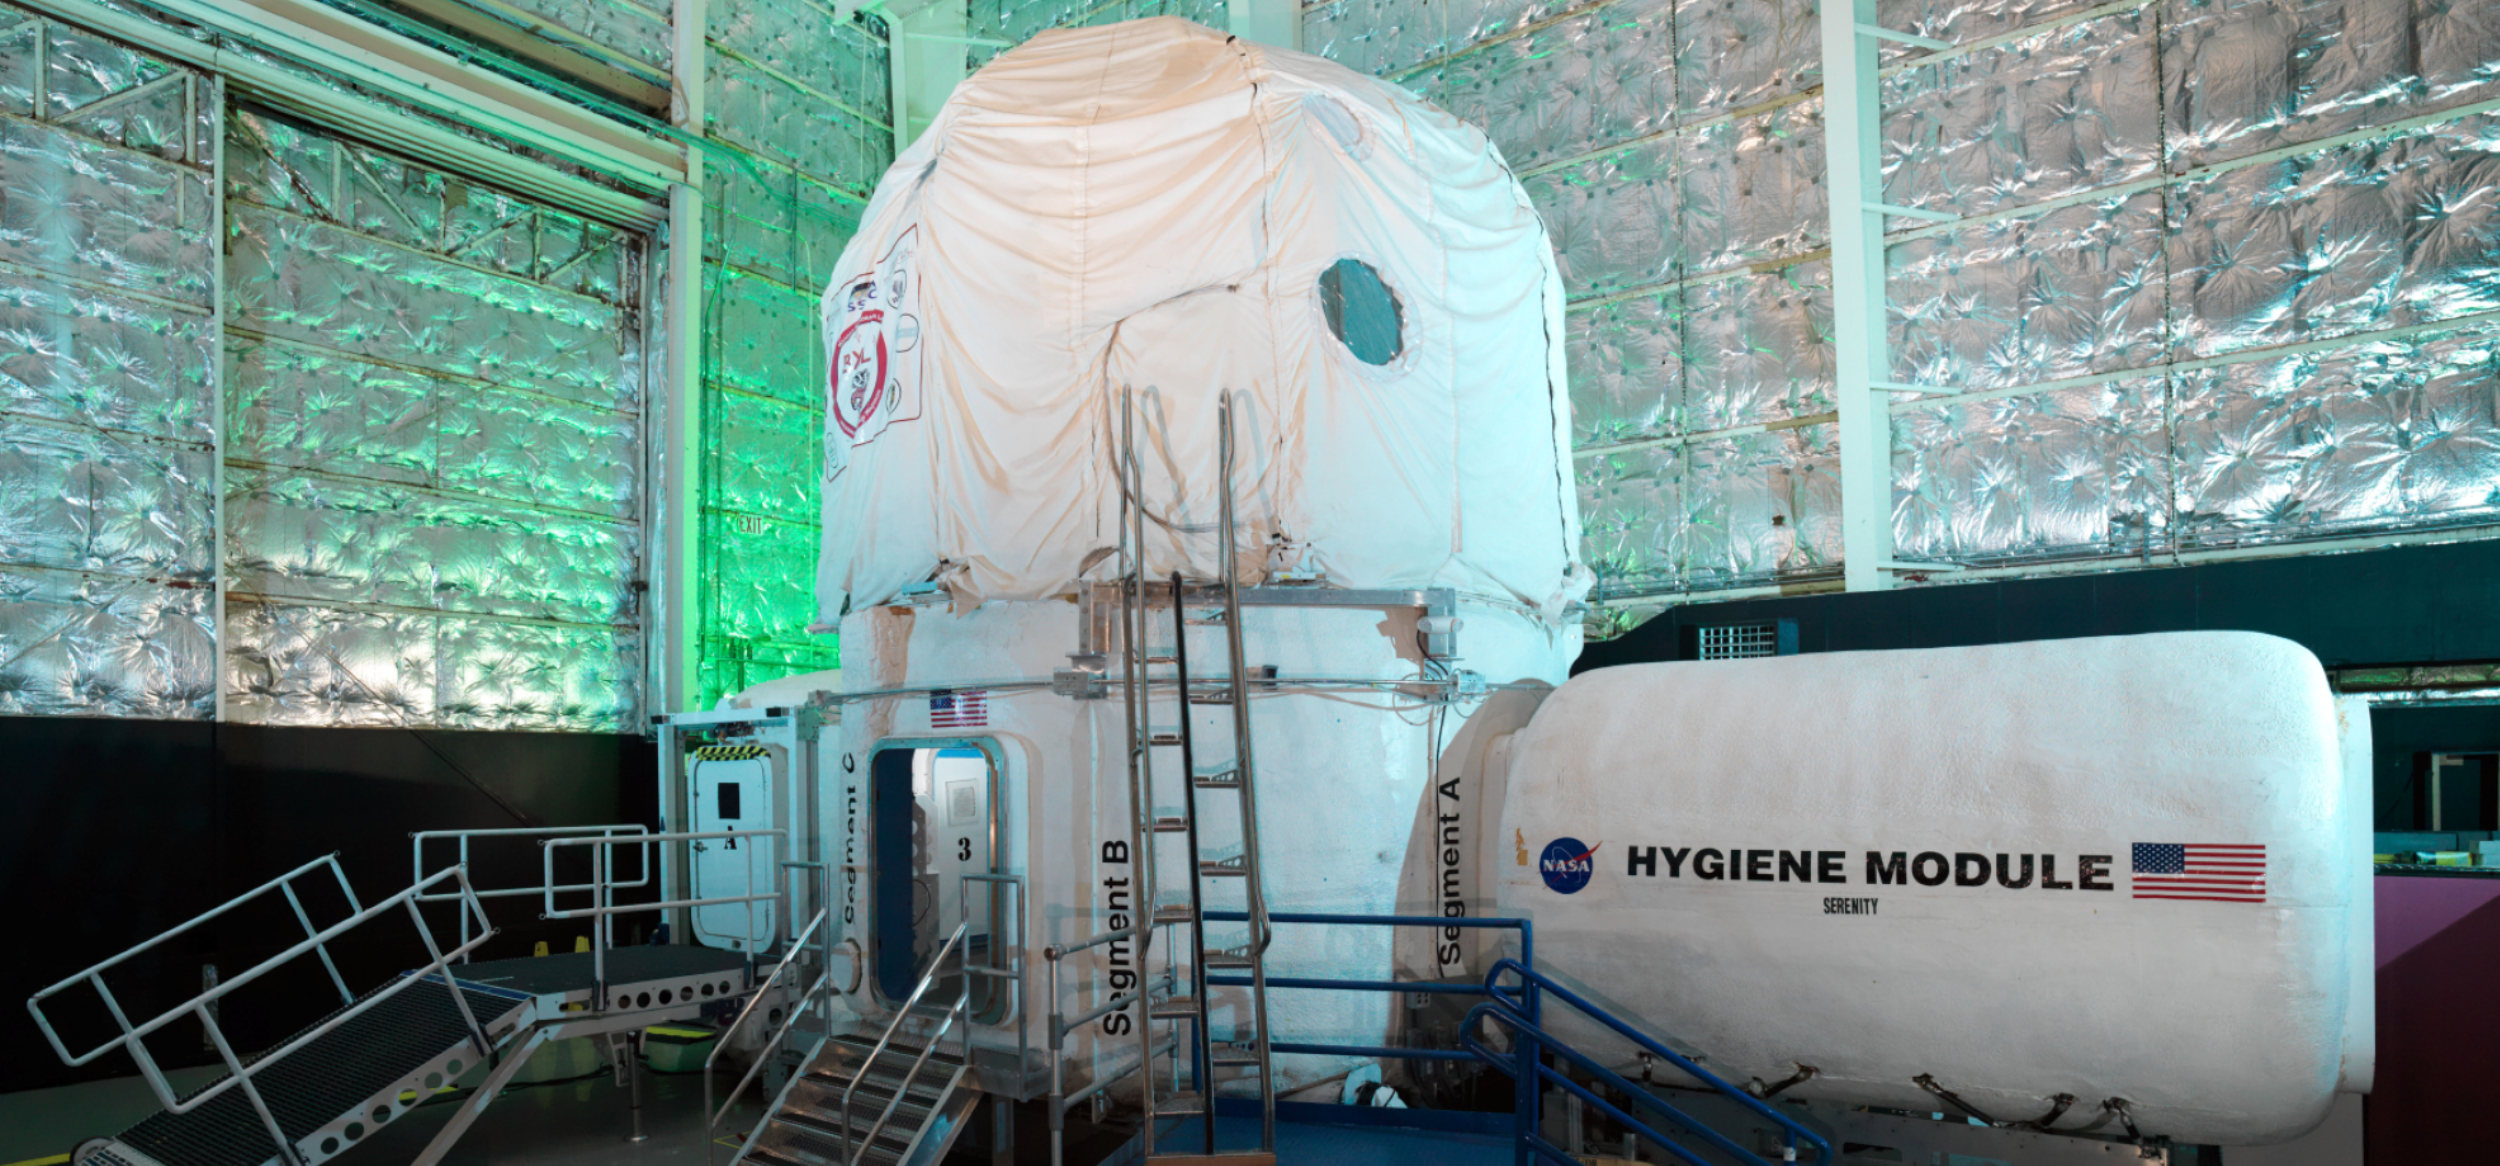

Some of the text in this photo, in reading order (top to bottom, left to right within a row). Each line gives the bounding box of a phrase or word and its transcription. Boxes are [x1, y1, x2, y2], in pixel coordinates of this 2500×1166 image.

[740, 514, 762, 535] EXIT
[842, 752, 855, 773] C
[724, 825, 737, 850] A
[958, 837, 971, 862] 3
[1102, 840, 1129, 863] B
[1438, 777, 1466, 965] Segment A
[1543, 859, 1590, 872] NASA
[1626, 845, 2115, 891] HYGIENE MODULE
[1823, 896, 1879, 916] SERENITY
